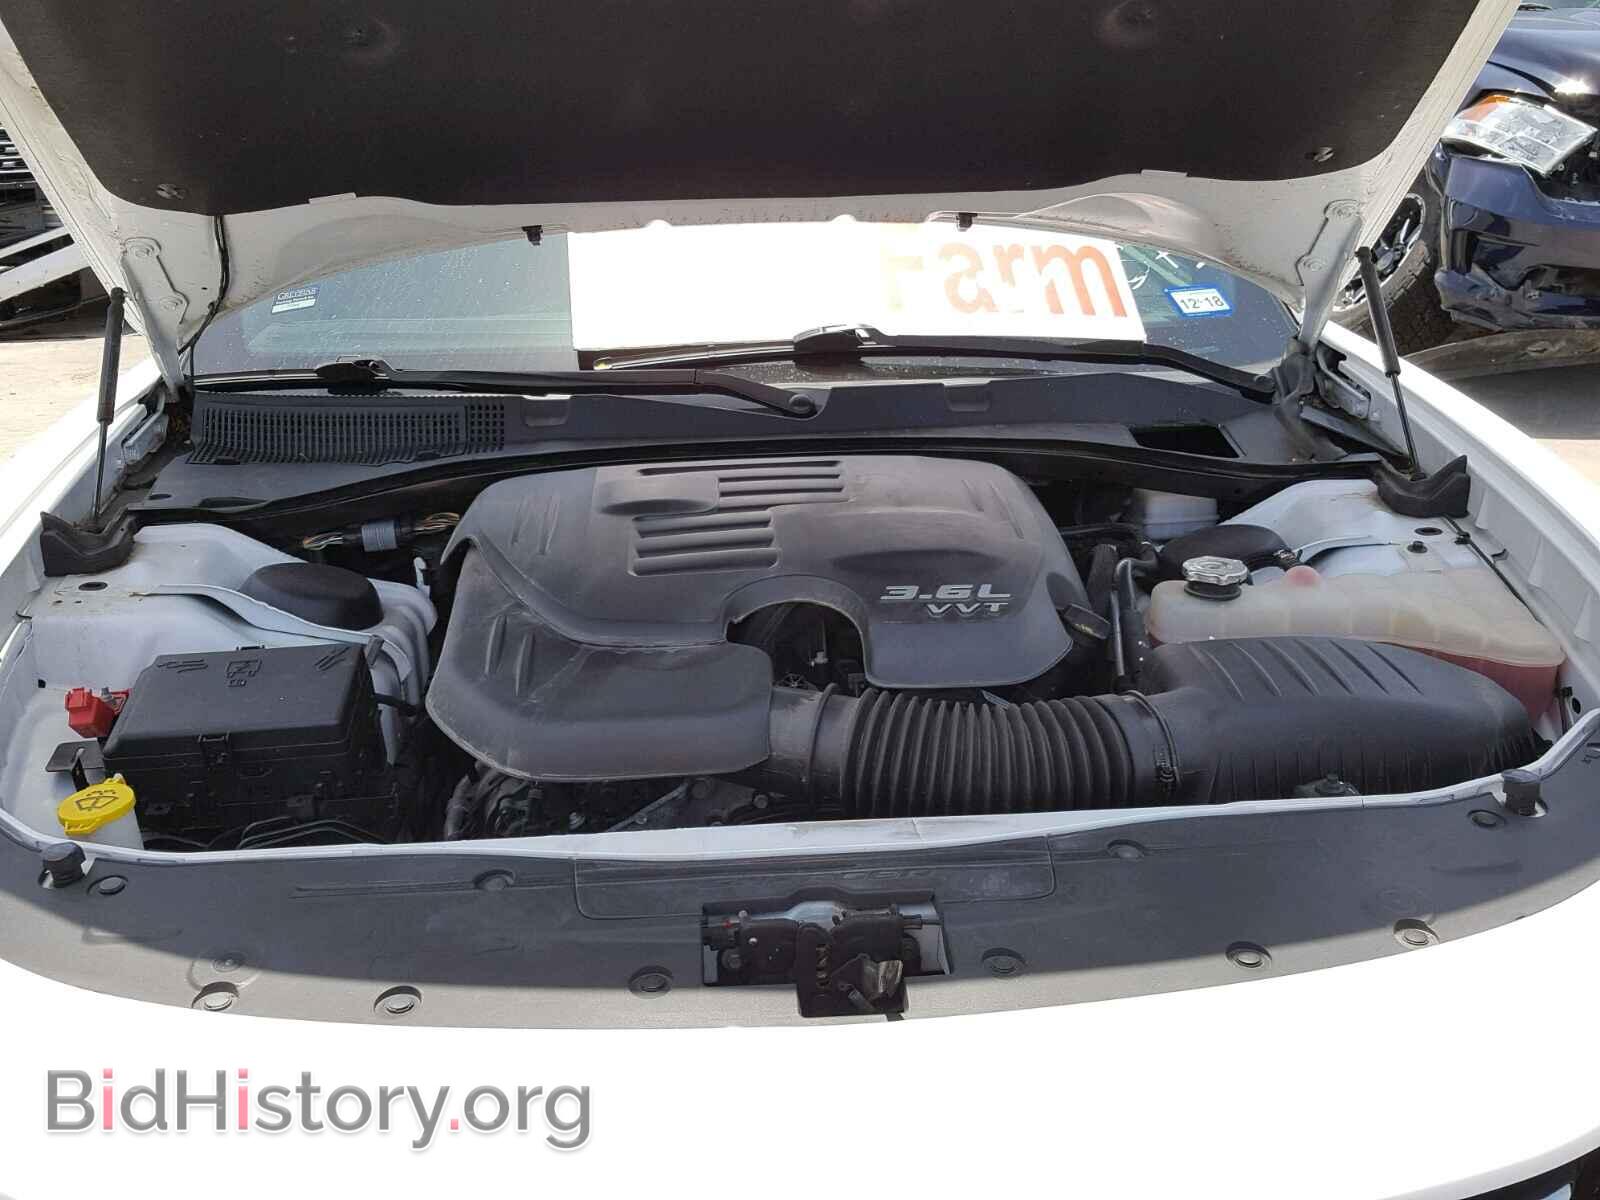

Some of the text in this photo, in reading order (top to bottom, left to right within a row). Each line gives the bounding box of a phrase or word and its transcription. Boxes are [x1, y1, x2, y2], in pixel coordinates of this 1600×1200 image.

[881, 224, 1128, 318] Farm
[880, 584, 1012, 600] 3.6L
[927, 602, 1009, 614] VVT
